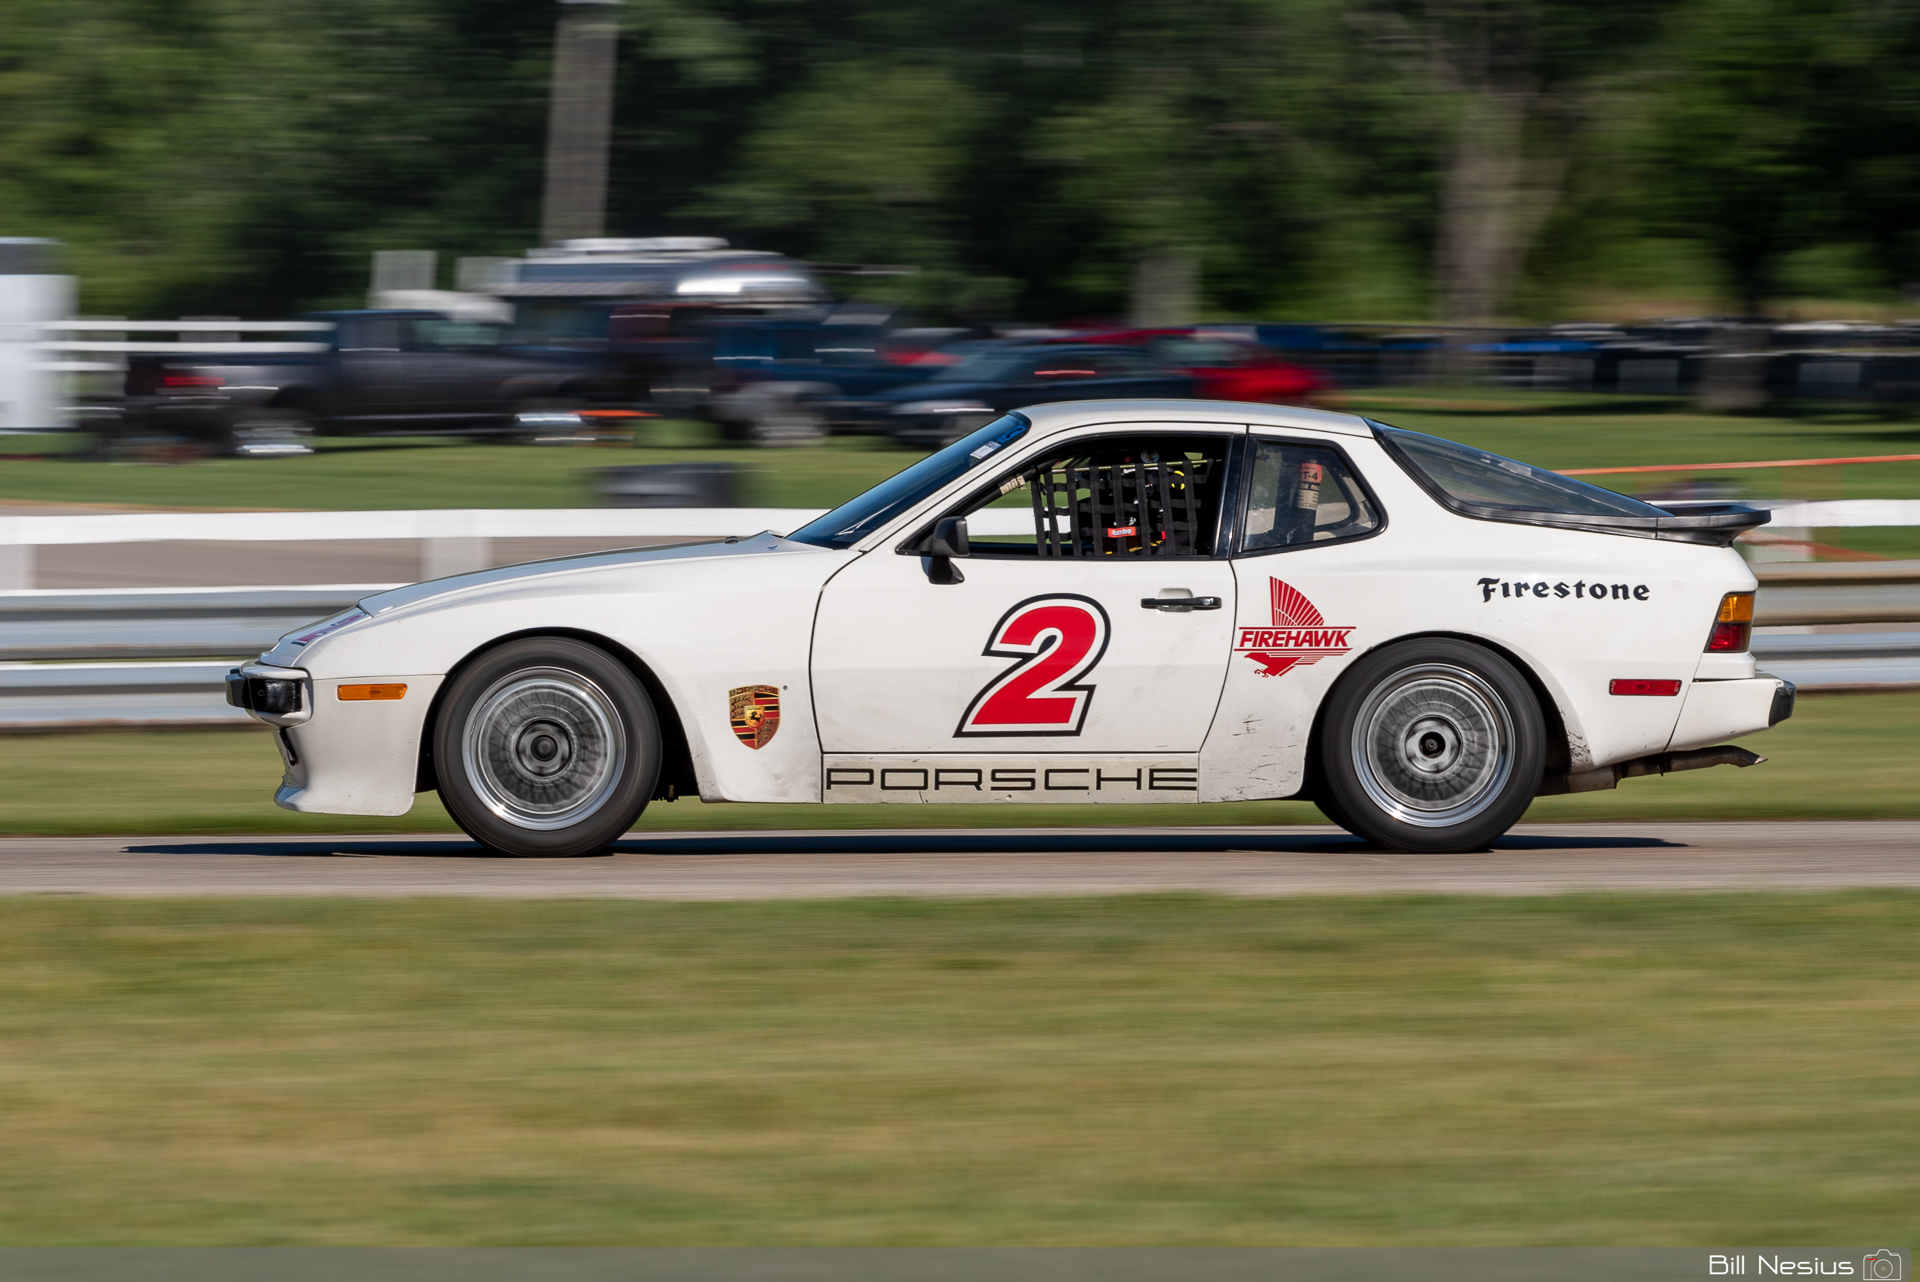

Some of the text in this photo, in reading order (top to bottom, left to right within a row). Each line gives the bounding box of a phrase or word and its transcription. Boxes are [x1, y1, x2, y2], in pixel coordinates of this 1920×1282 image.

[1477, 577, 1650, 603] Firestone
[1239, 630, 1351, 648] FIREHAWK
[952, 593, 1112, 738] 2
[826, 767, 1198, 791] PORSCHE
